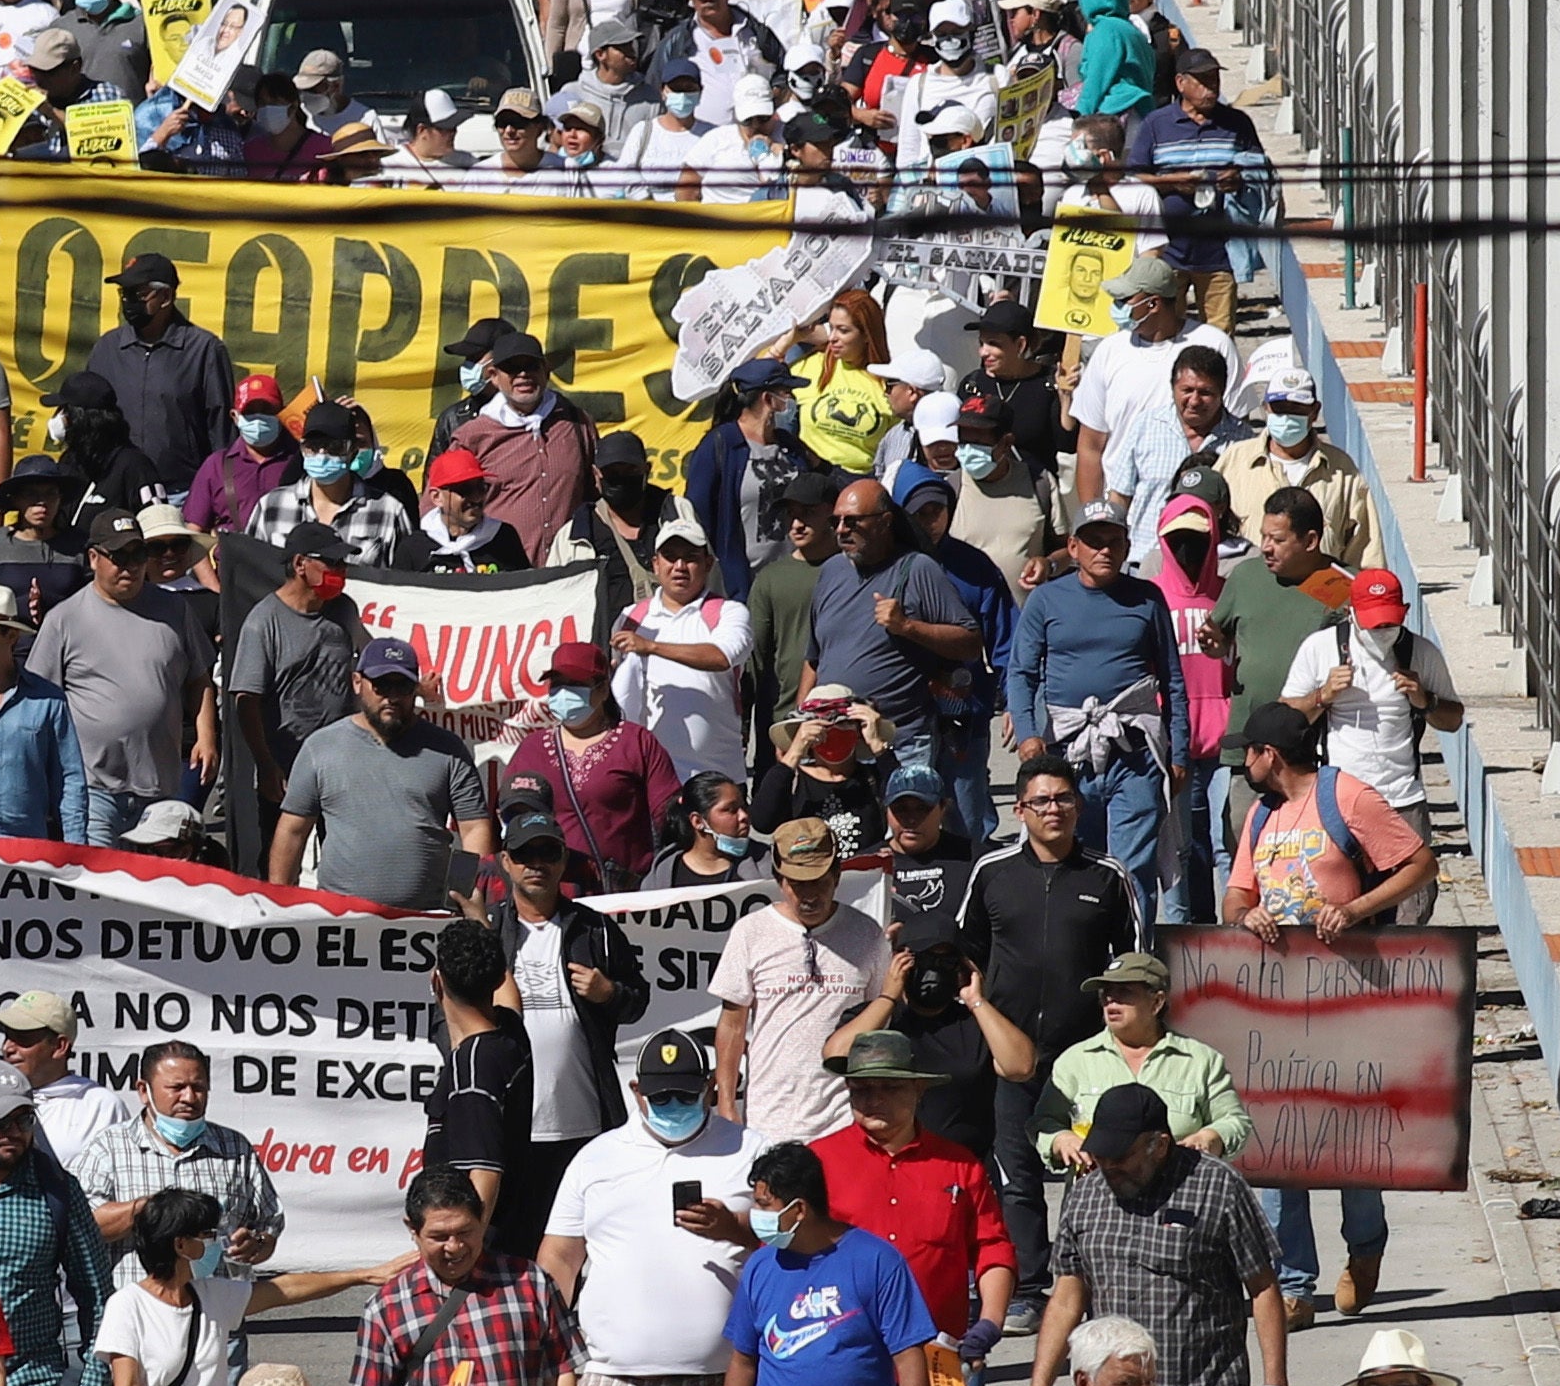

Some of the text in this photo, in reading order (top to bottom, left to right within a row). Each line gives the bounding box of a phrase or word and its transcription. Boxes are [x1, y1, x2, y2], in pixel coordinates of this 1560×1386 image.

[1063, 227, 1120, 249] ¡LIBRE!
[886, 243, 1047, 279] EL SALVADO
[693, 295, 741, 346] EL
[1084, 502, 1114, 516] USA
[100, 919, 301, 966] DETUVO
[315, 925, 369, 968] EL
[115, 992, 198, 1032] NO
[211, 992, 318, 1038] NOS
[232, 1054, 296, 1096] DE
[347, 1149, 390, 1174] en
